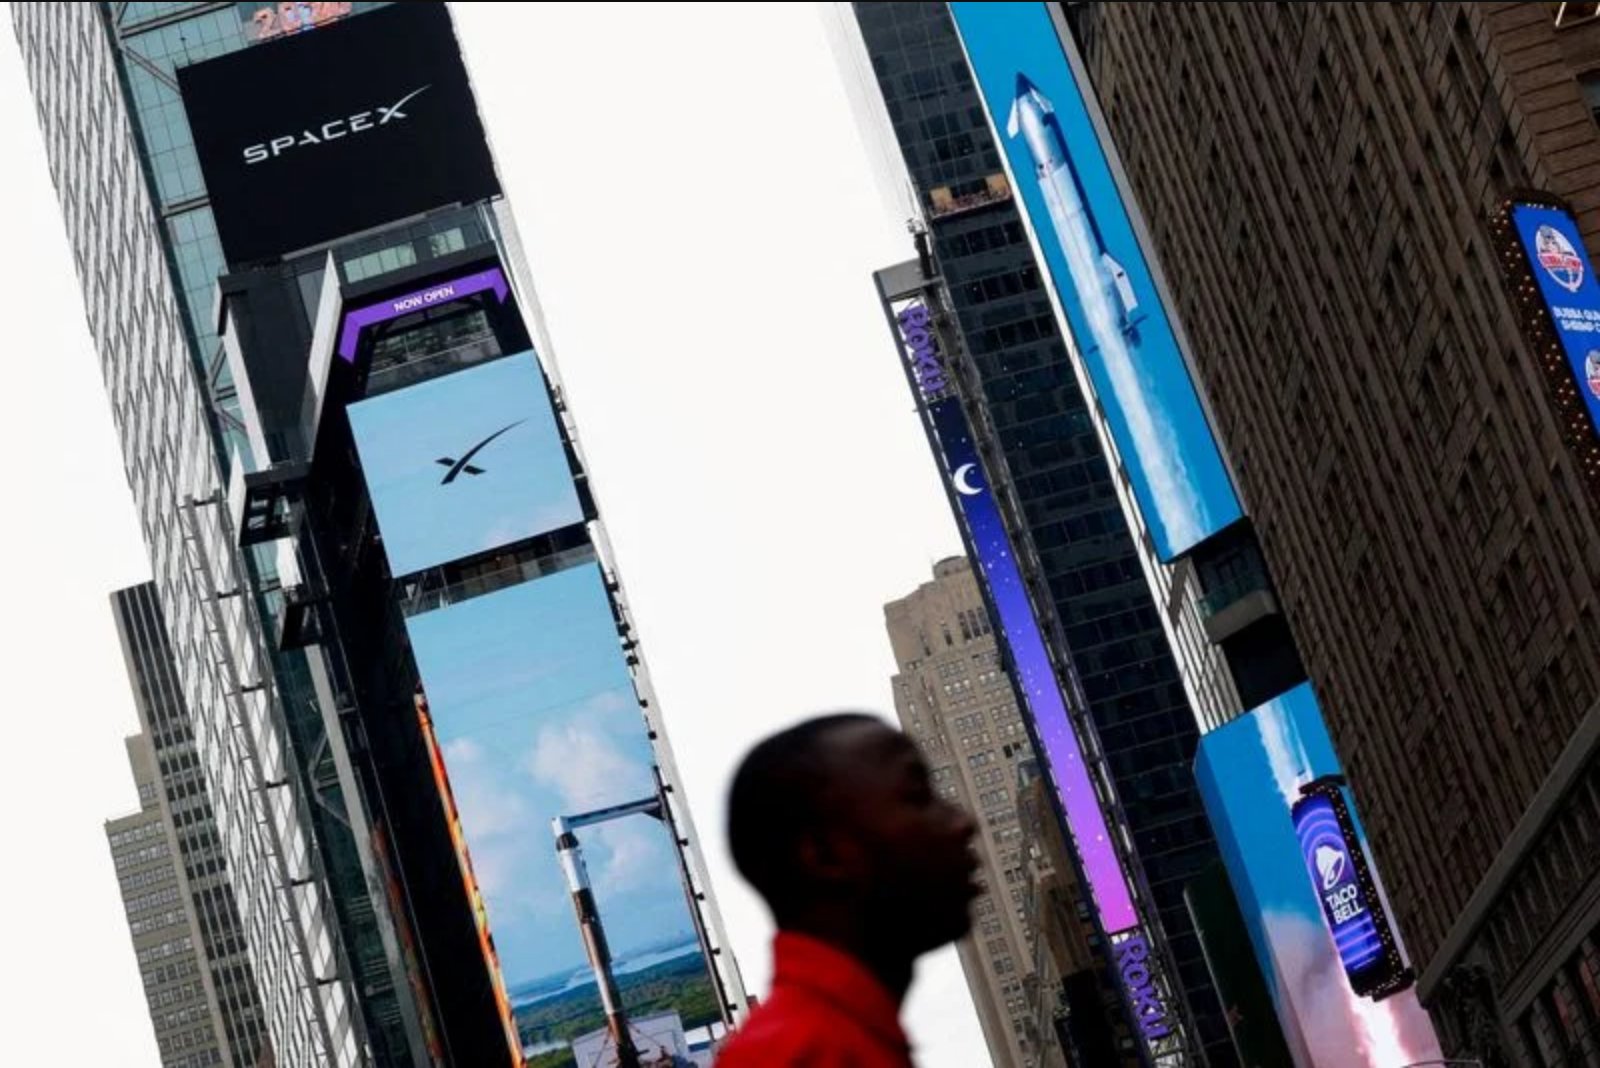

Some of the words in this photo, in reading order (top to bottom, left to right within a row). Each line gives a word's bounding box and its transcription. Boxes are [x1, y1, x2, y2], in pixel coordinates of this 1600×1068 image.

[243, 84, 432, 164] SPACEX
[393, 295, 423, 312] NOW
[423, 285, 455, 303] OPEN
[1326, 883, 1358, 910] TACO
[1333, 900, 1364, 925] BELL
